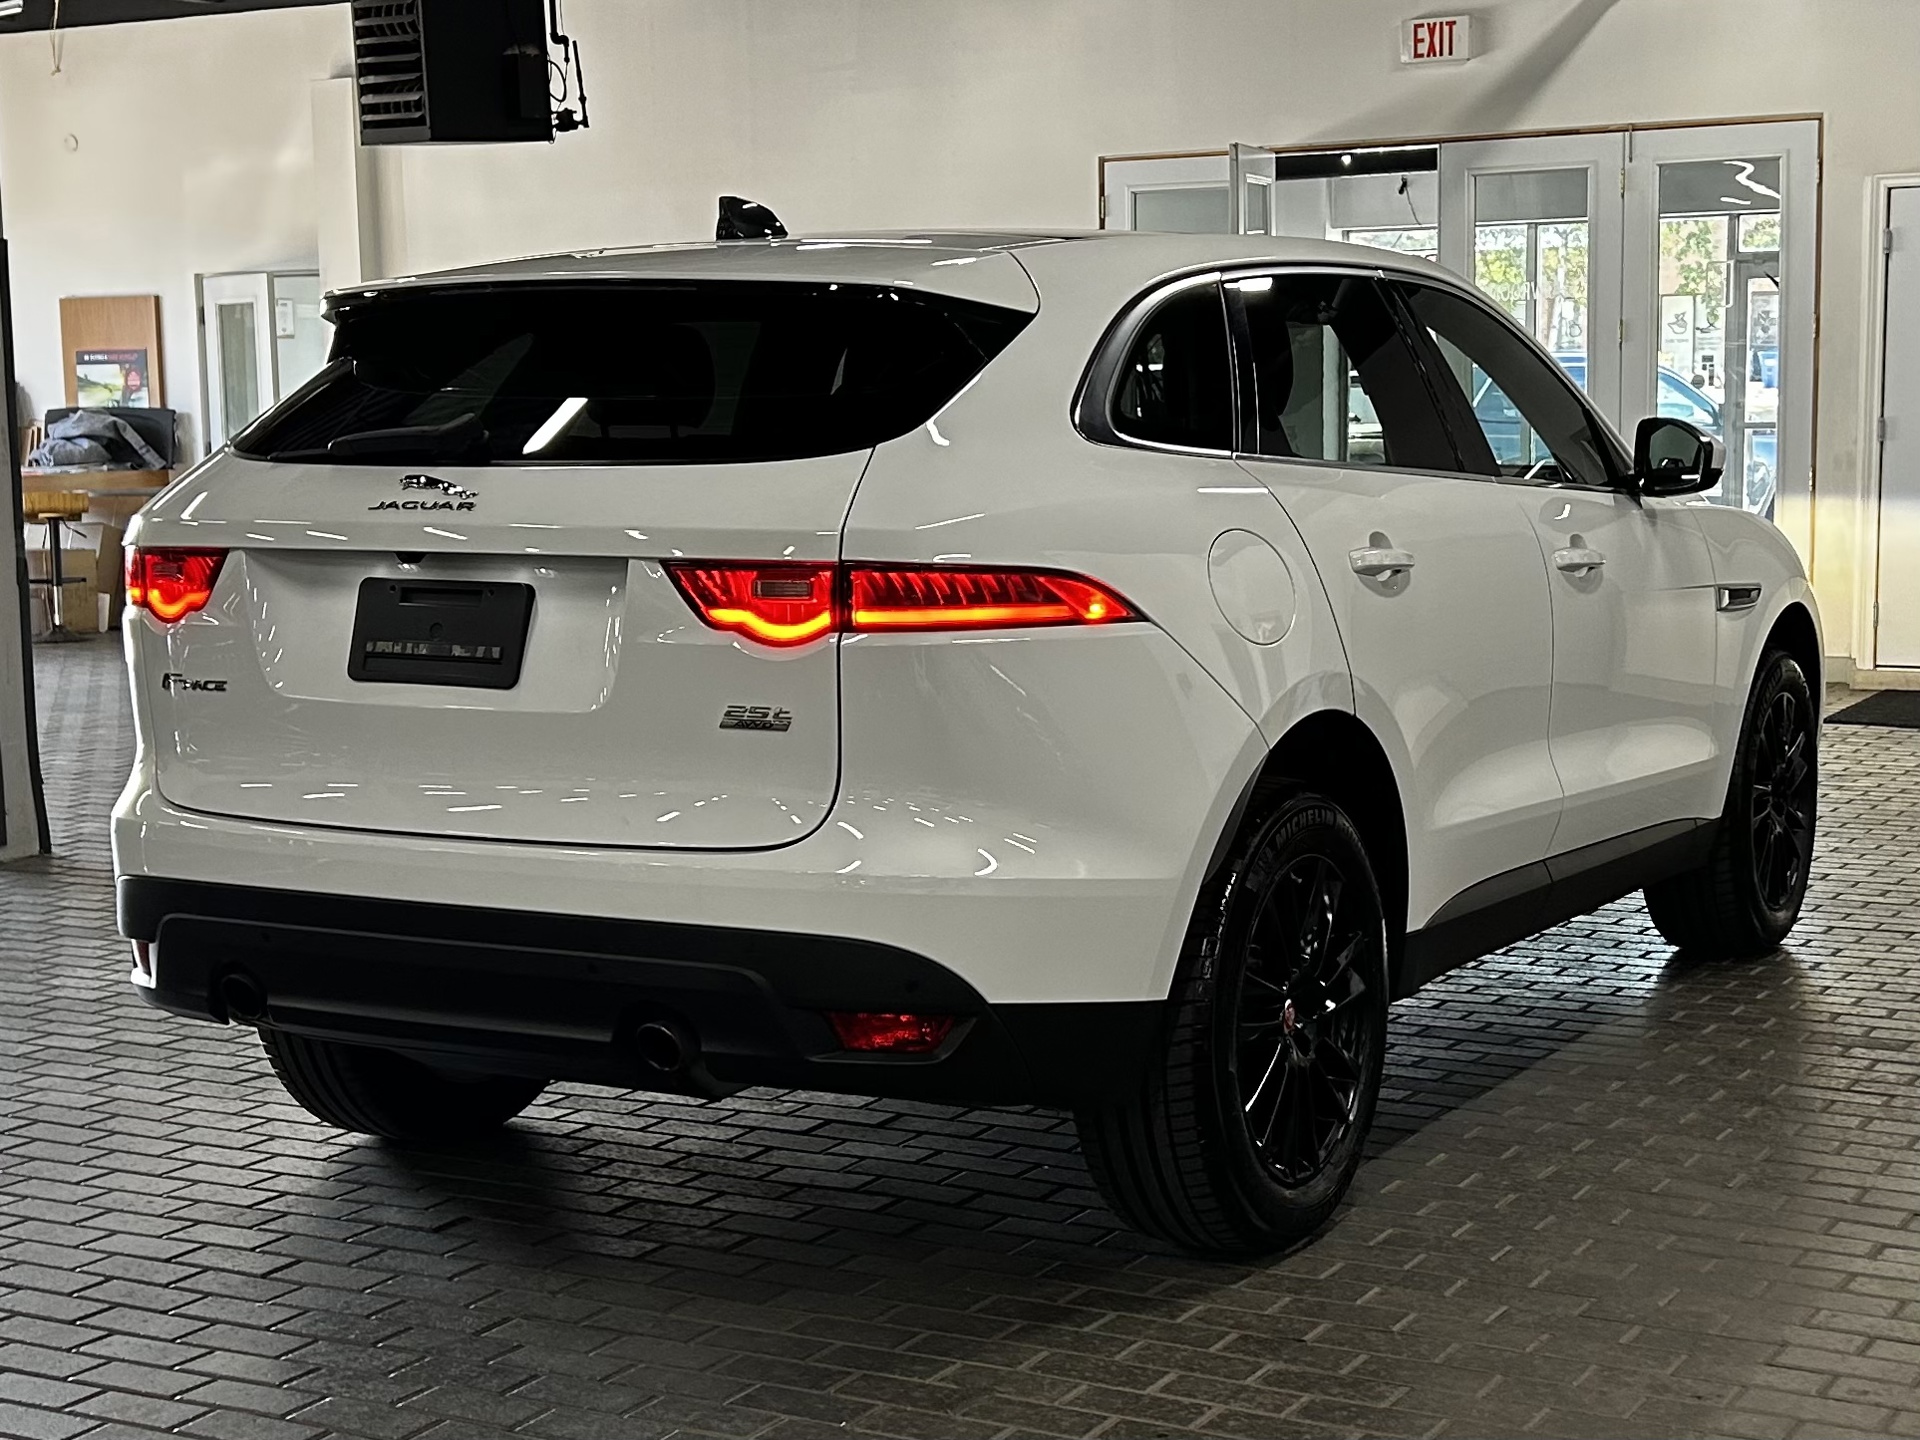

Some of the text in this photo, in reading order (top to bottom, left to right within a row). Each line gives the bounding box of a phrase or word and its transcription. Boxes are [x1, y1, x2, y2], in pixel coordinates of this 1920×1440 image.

[1413, 20, 1457, 59] EXIT
[367, 500, 476, 512] JAGUAR
[1275, 808, 1335, 850] MICHELIN
